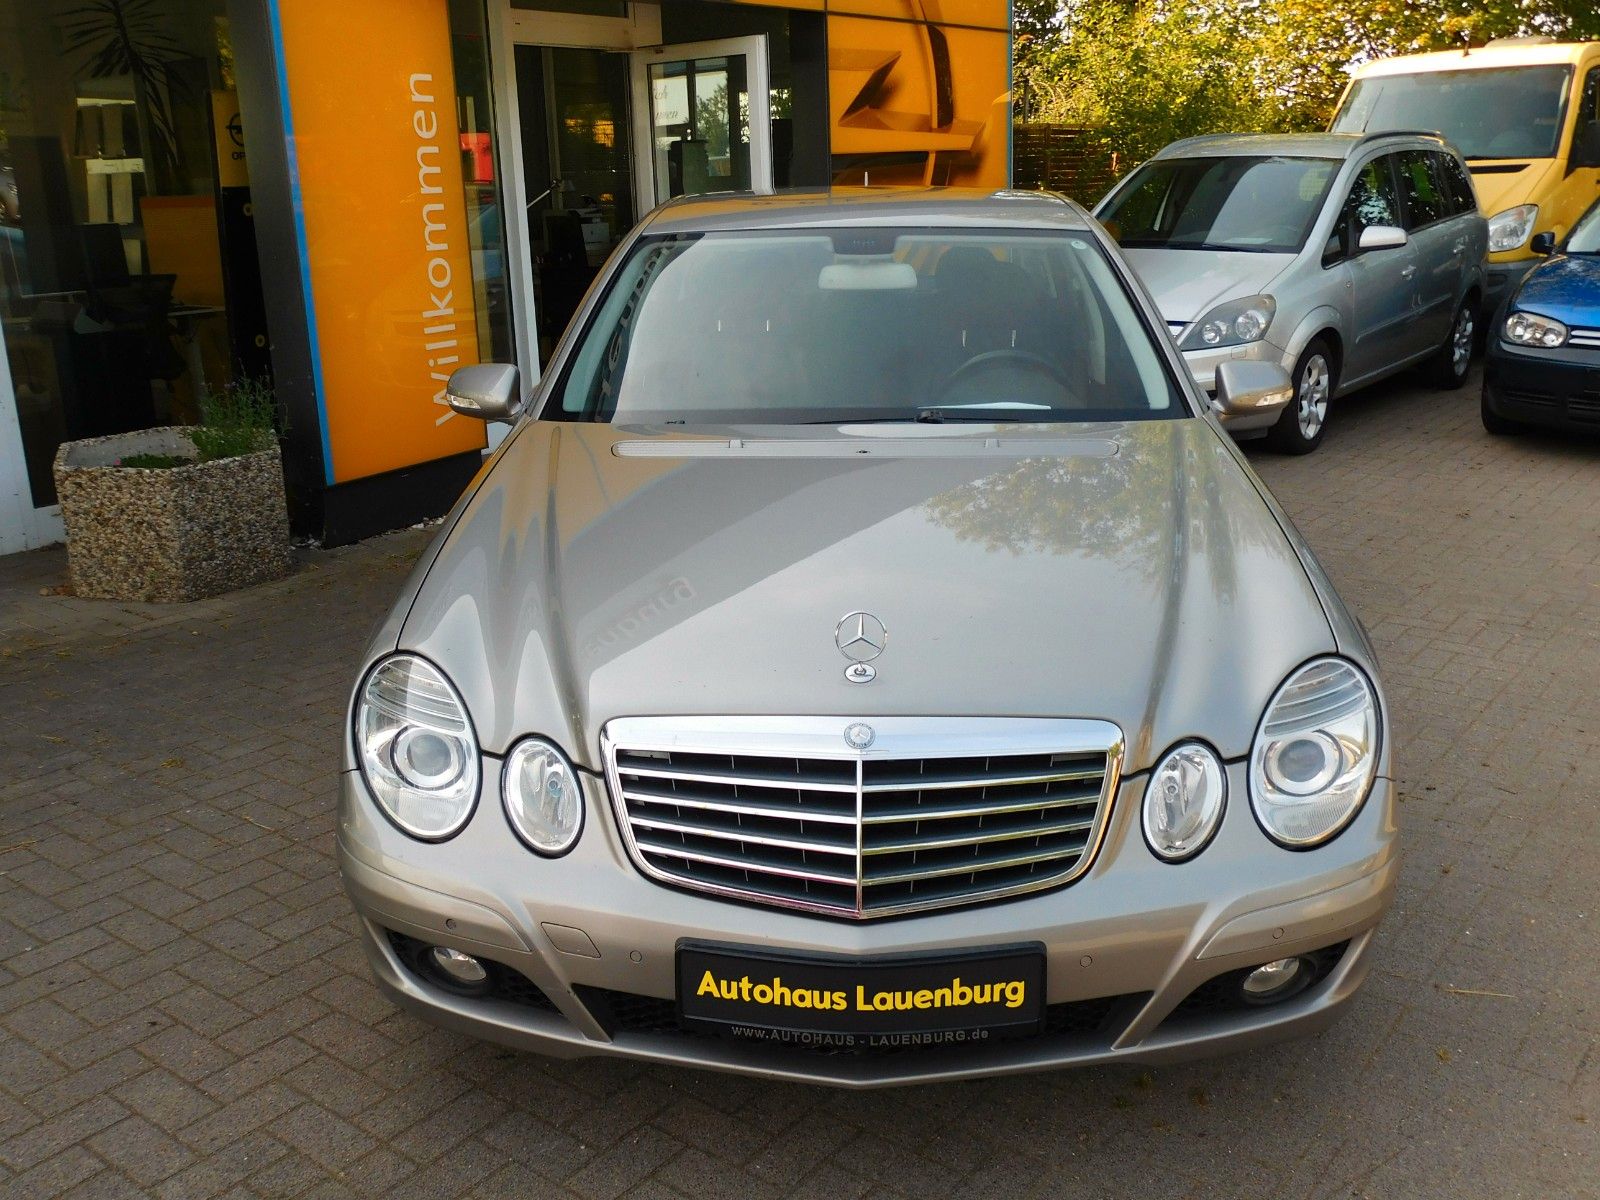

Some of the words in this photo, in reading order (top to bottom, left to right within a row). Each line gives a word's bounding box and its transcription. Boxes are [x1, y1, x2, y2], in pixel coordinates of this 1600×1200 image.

[409, 72, 459, 428] Willkommen
[696, 970, 848, 1011] Autohaus
[856, 977, 1025, 1011] Lauenburg
